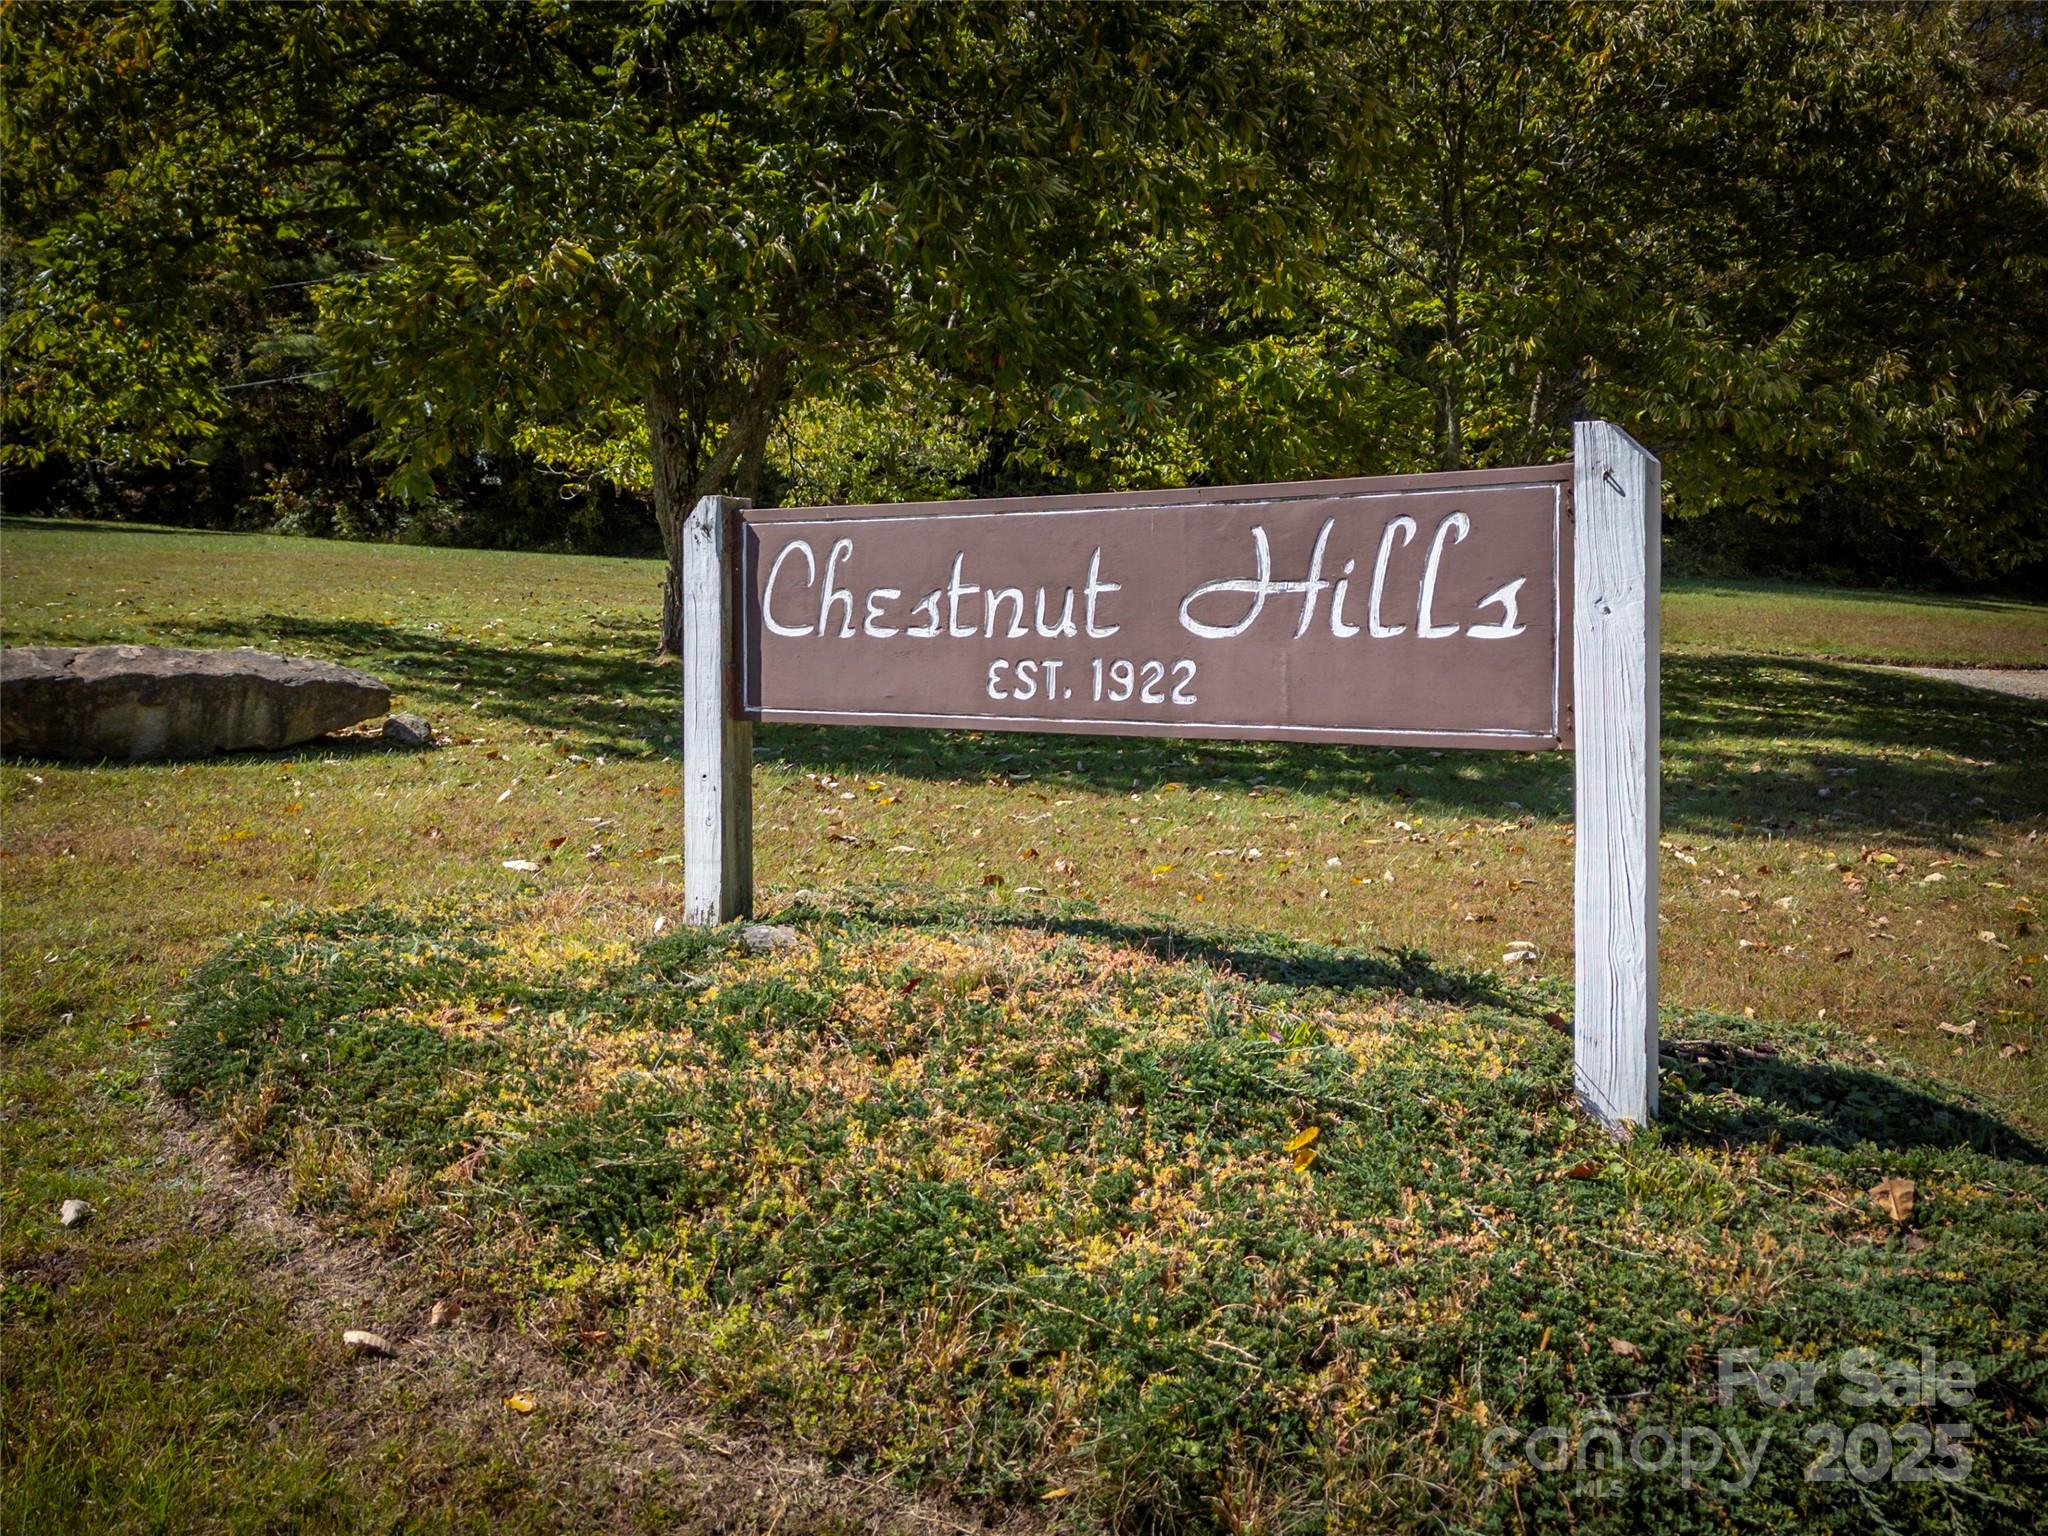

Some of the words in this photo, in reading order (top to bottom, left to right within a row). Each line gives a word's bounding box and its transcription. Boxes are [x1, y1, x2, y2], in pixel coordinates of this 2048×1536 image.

[763, 537, 1121, 640] Chestnut
[1179, 511, 1527, 640] Hills
[986, 658, 1072, 702] EST.
[1092, 658, 1198, 706] 1922
